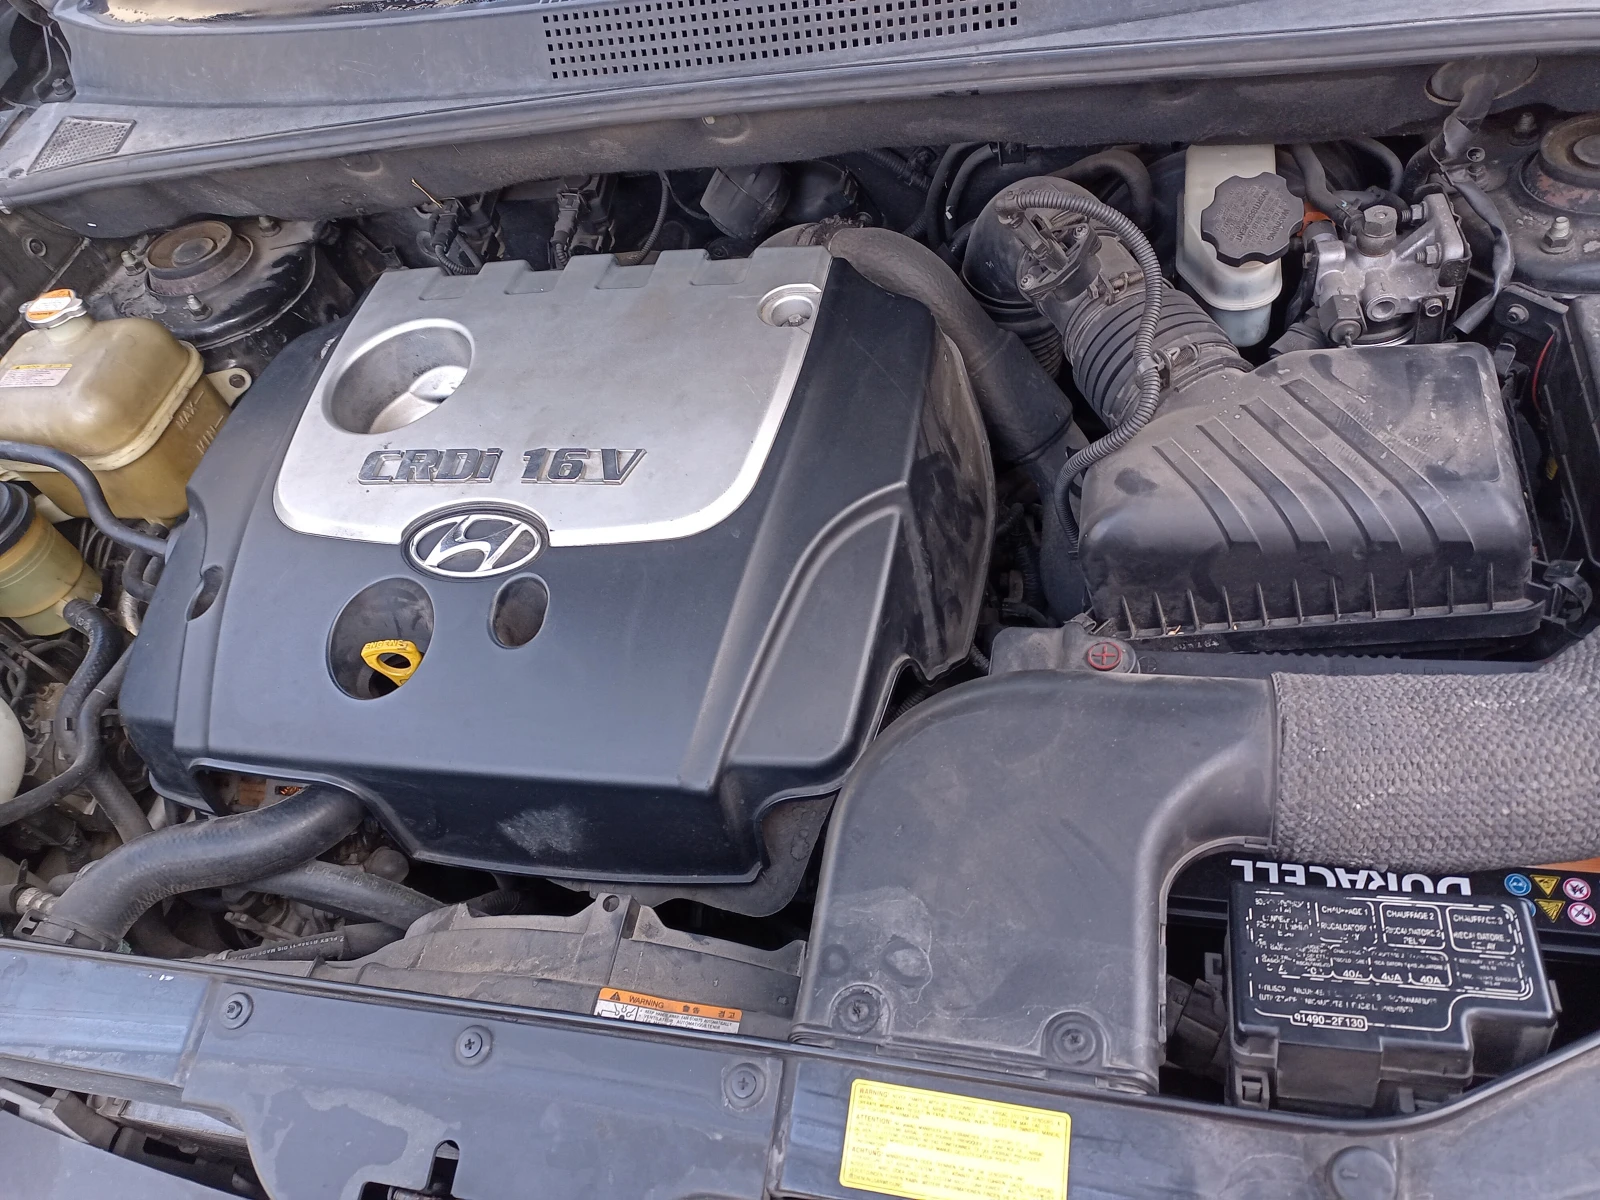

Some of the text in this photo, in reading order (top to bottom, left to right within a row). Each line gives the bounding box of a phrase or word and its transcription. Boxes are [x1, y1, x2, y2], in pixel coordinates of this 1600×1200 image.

[176, 401, 197, 430] MAX
[357, 448, 503, 485] CRDi
[1420, 975, 1442, 984] 40A
[629, 996, 664, 1009] WARNING
[1294, 1013, 1364, 1027] 91490-2F130
